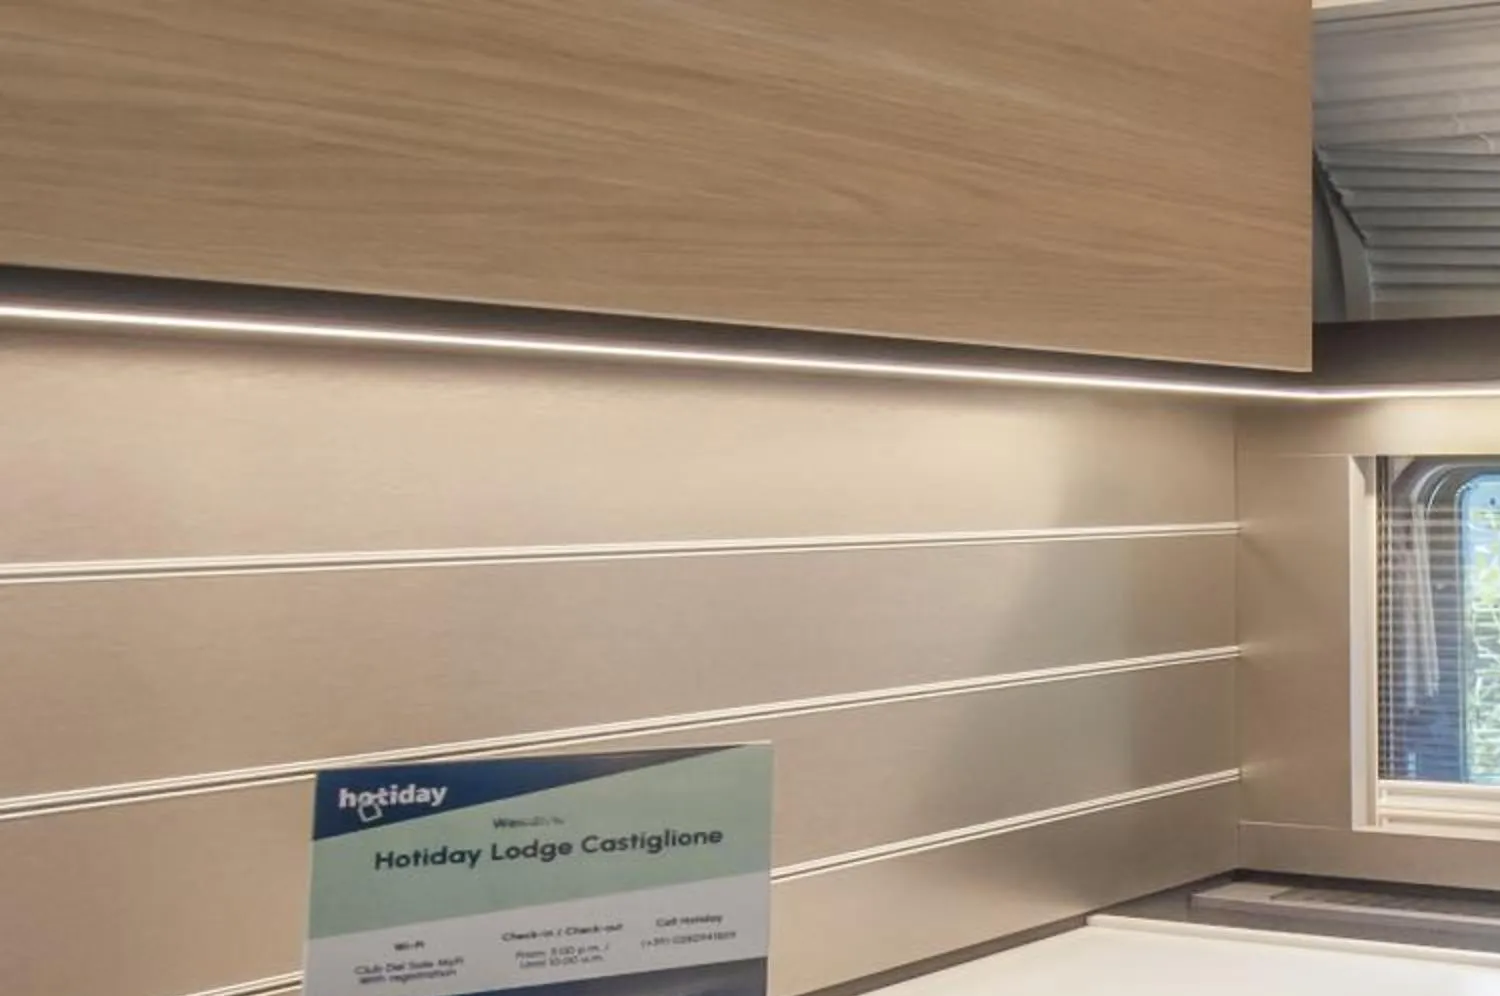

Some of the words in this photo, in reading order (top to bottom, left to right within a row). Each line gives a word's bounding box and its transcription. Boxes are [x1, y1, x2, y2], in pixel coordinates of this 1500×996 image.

[338, 783, 448, 808] hotiday
[374, 845, 482, 870] Hotiday
[491, 839, 573, 862] Lodge
[581, 828, 723, 854] Castiglione
